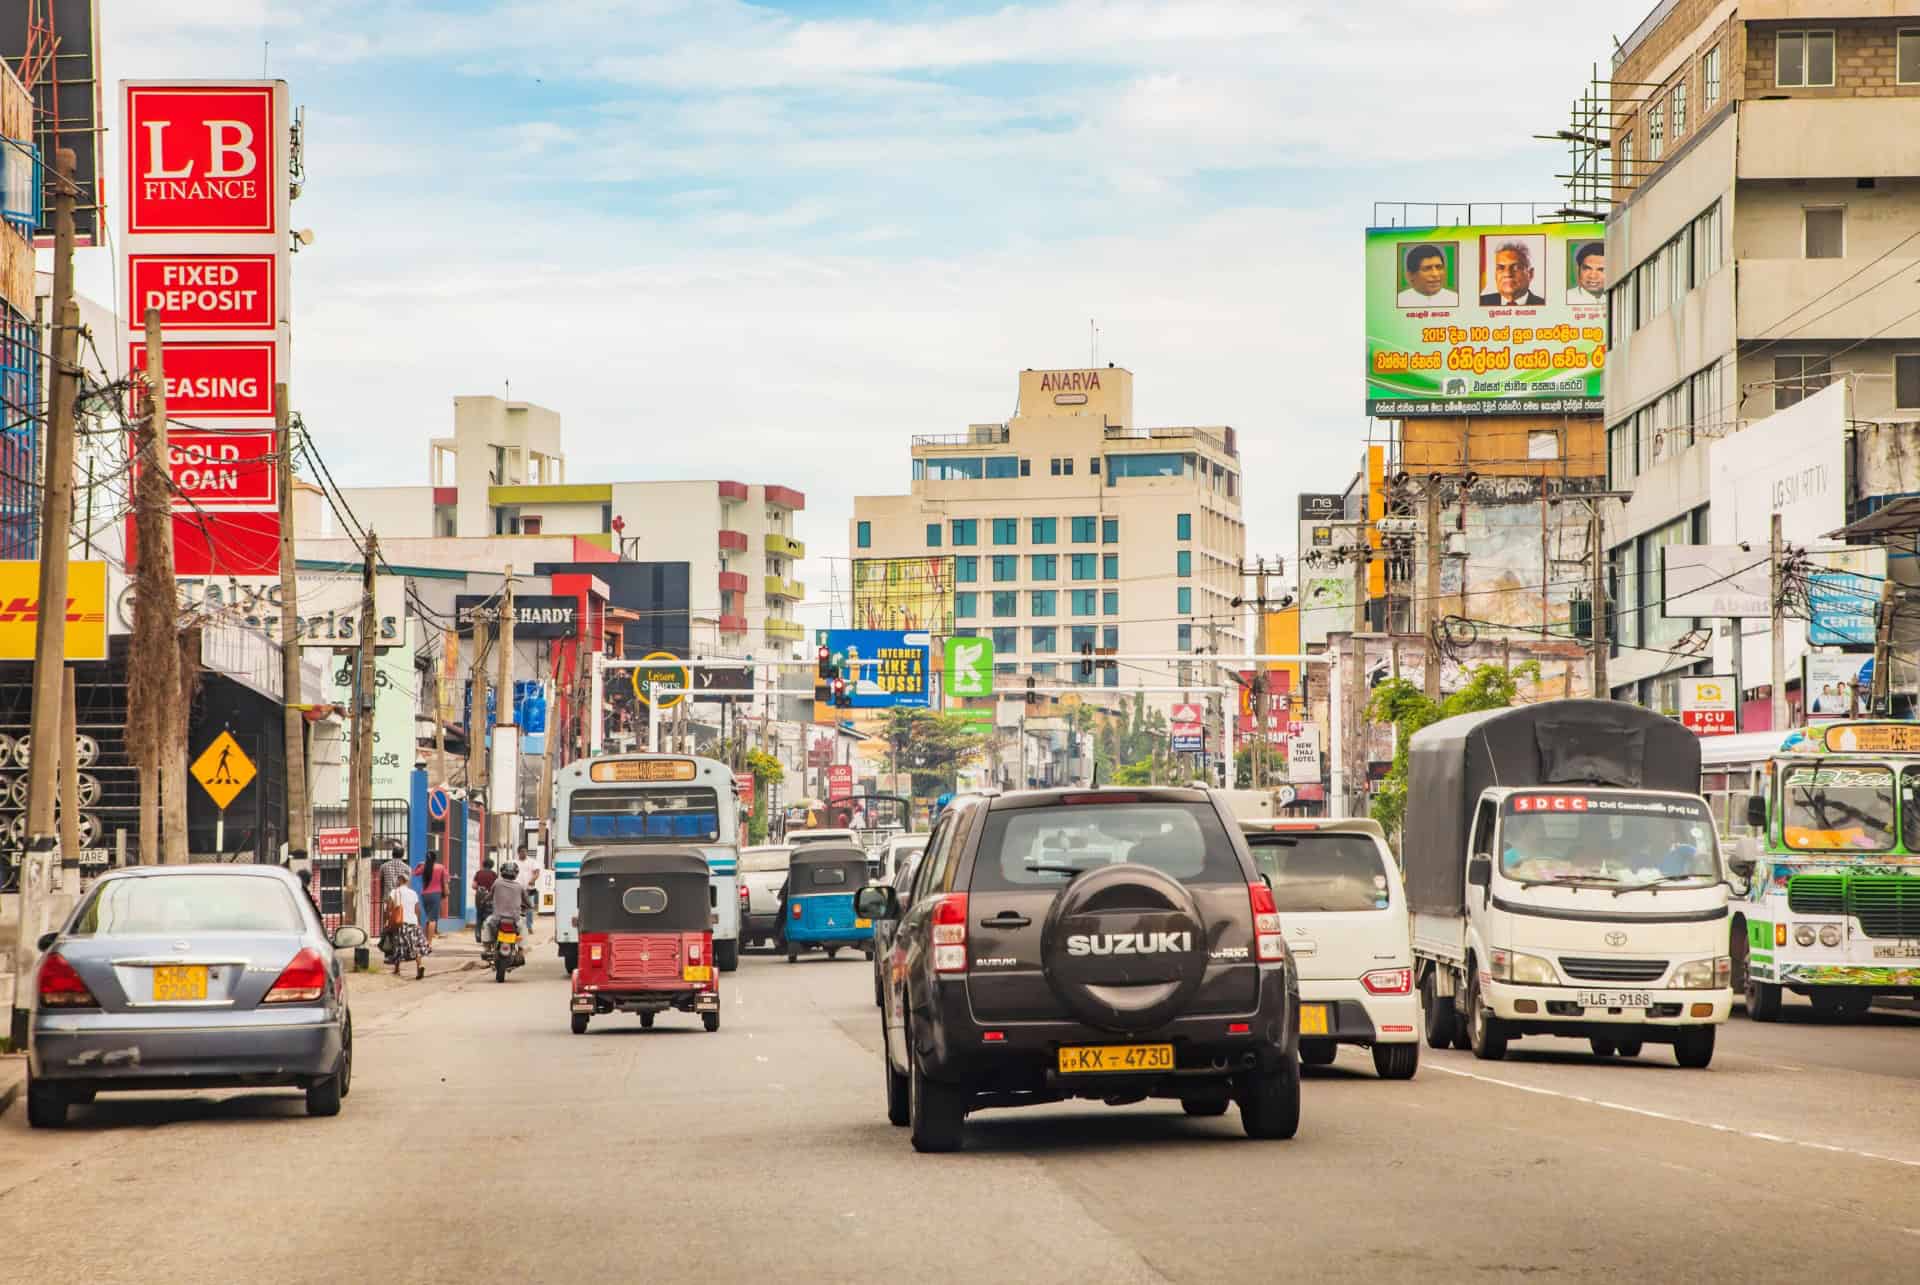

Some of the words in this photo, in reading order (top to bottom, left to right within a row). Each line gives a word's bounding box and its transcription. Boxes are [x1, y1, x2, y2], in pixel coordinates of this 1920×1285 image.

[144, 180, 256, 199] FINANCE
[163, 266, 238, 286] FIXED
[146, 290, 256, 311] DEPOSIT
[1422, 327, 1446, 342] 2015
[1470, 327, 1489, 342] 100
[165, 379, 257, 399] EASING
[1041, 372, 1101, 392] ANARVA
[168, 444, 240, 465] GOLD
[521, 607, 573, 624] HARDY
[877, 648, 922, 659] INTERNET
[877, 660, 908, 675] LIKE
[914, 660, 922, 675] A
[877, 676, 922, 693] BOSS!
[1695, 711, 1726, 723] PCU
[1067, 932, 1192, 957] SUZUKI
